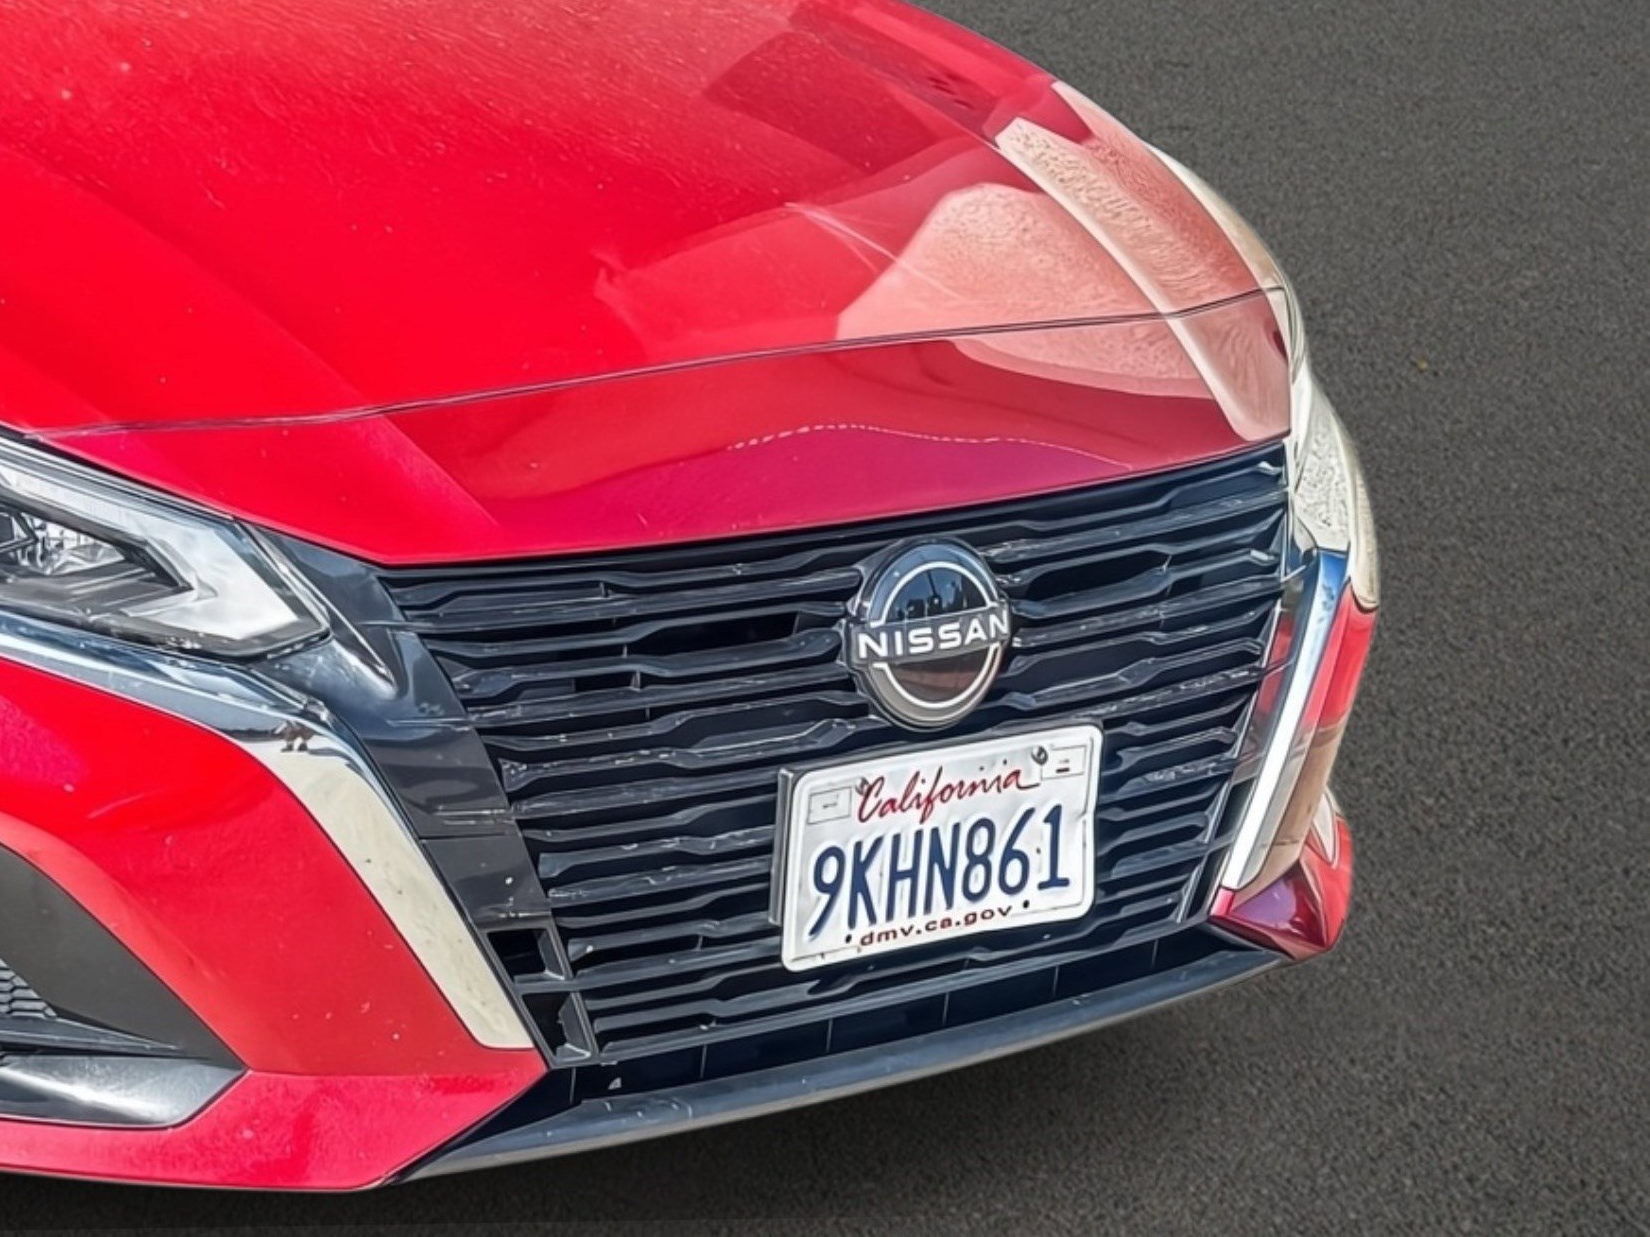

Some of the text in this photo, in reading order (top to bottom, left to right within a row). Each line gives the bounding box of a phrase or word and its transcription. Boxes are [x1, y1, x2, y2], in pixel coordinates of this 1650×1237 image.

[857, 607, 1010, 661] NISSAN
[857, 761, 1041, 824] California
[808, 804, 1071, 937] 9KHN861
[858, 905, 1013, 947] dmv.ca.gov
